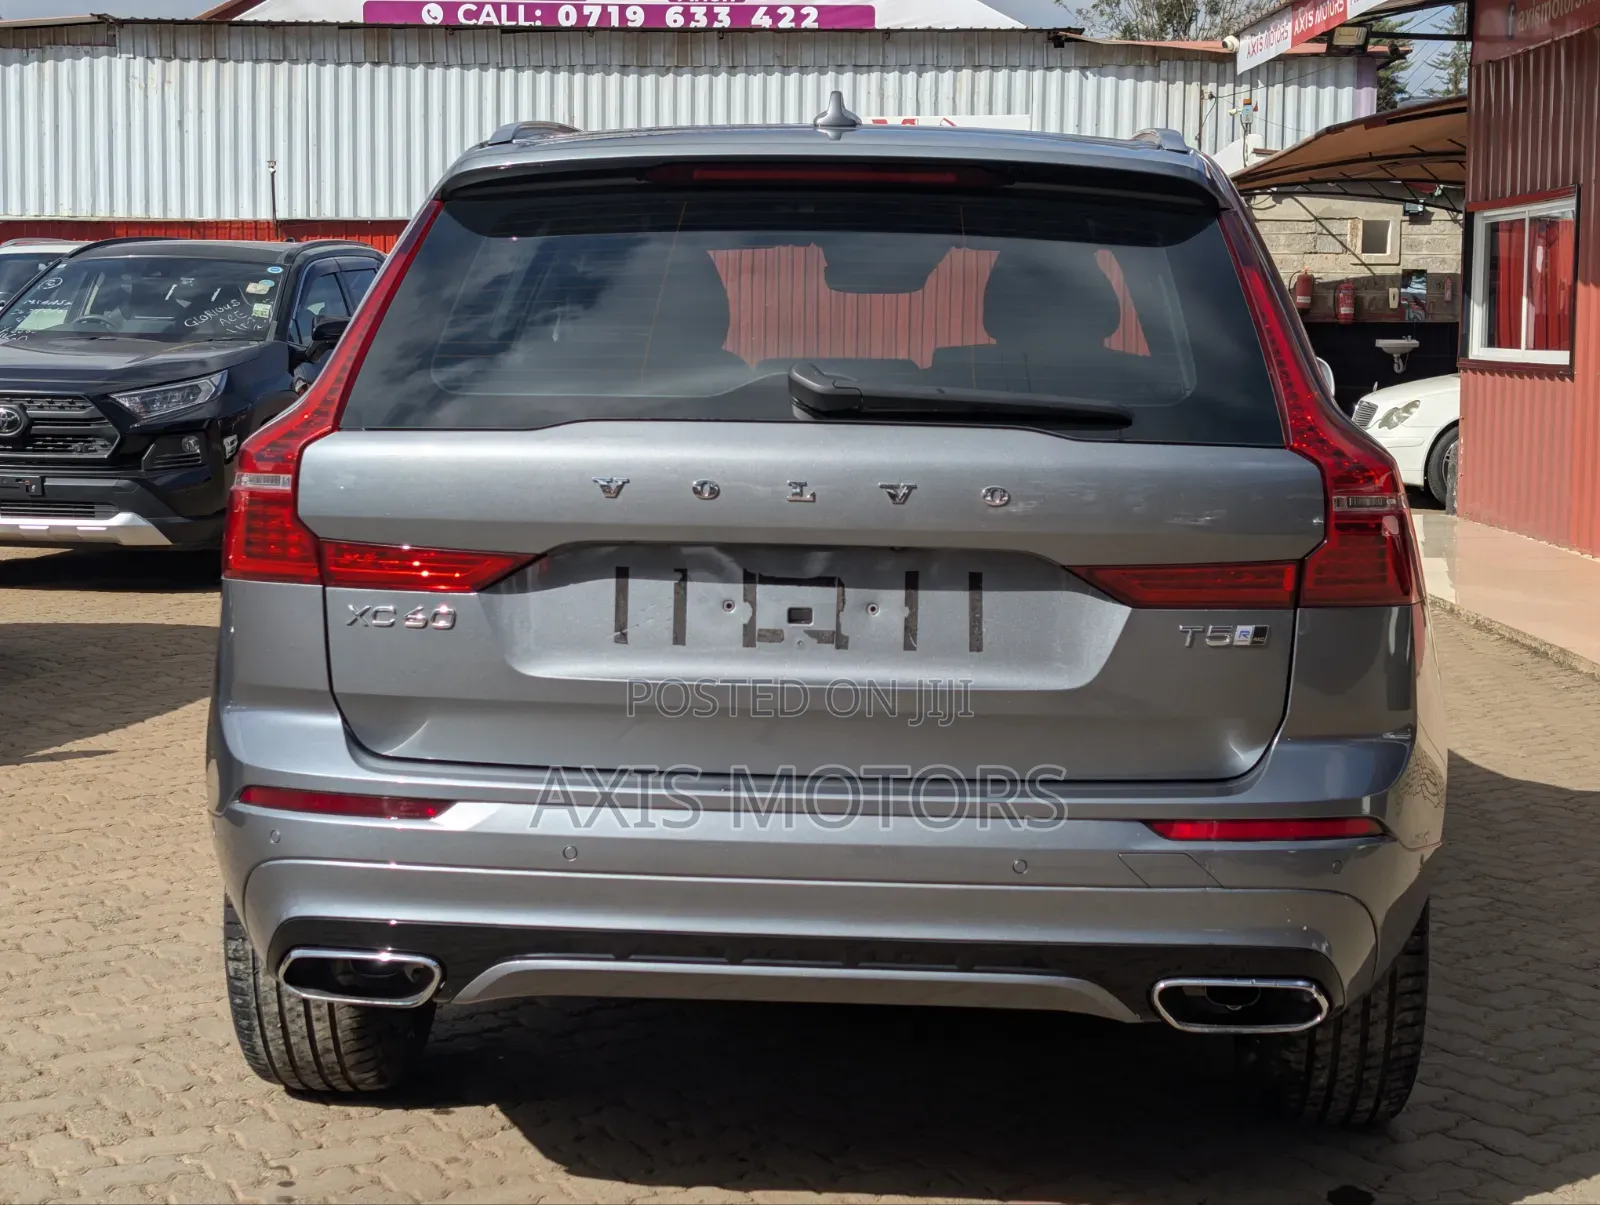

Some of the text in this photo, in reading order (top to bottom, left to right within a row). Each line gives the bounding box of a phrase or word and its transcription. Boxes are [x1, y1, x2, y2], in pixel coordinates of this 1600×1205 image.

[457, 4, 819, 28] CALL: 0719 633 422
[1294, 0, 1345, 35] AXIS MOTORS
[1246, 21, 1290, 59] AXIS MOTORS
[592, 476, 1012, 508] VOLVO
[1179, 625, 1233, 647] T5
